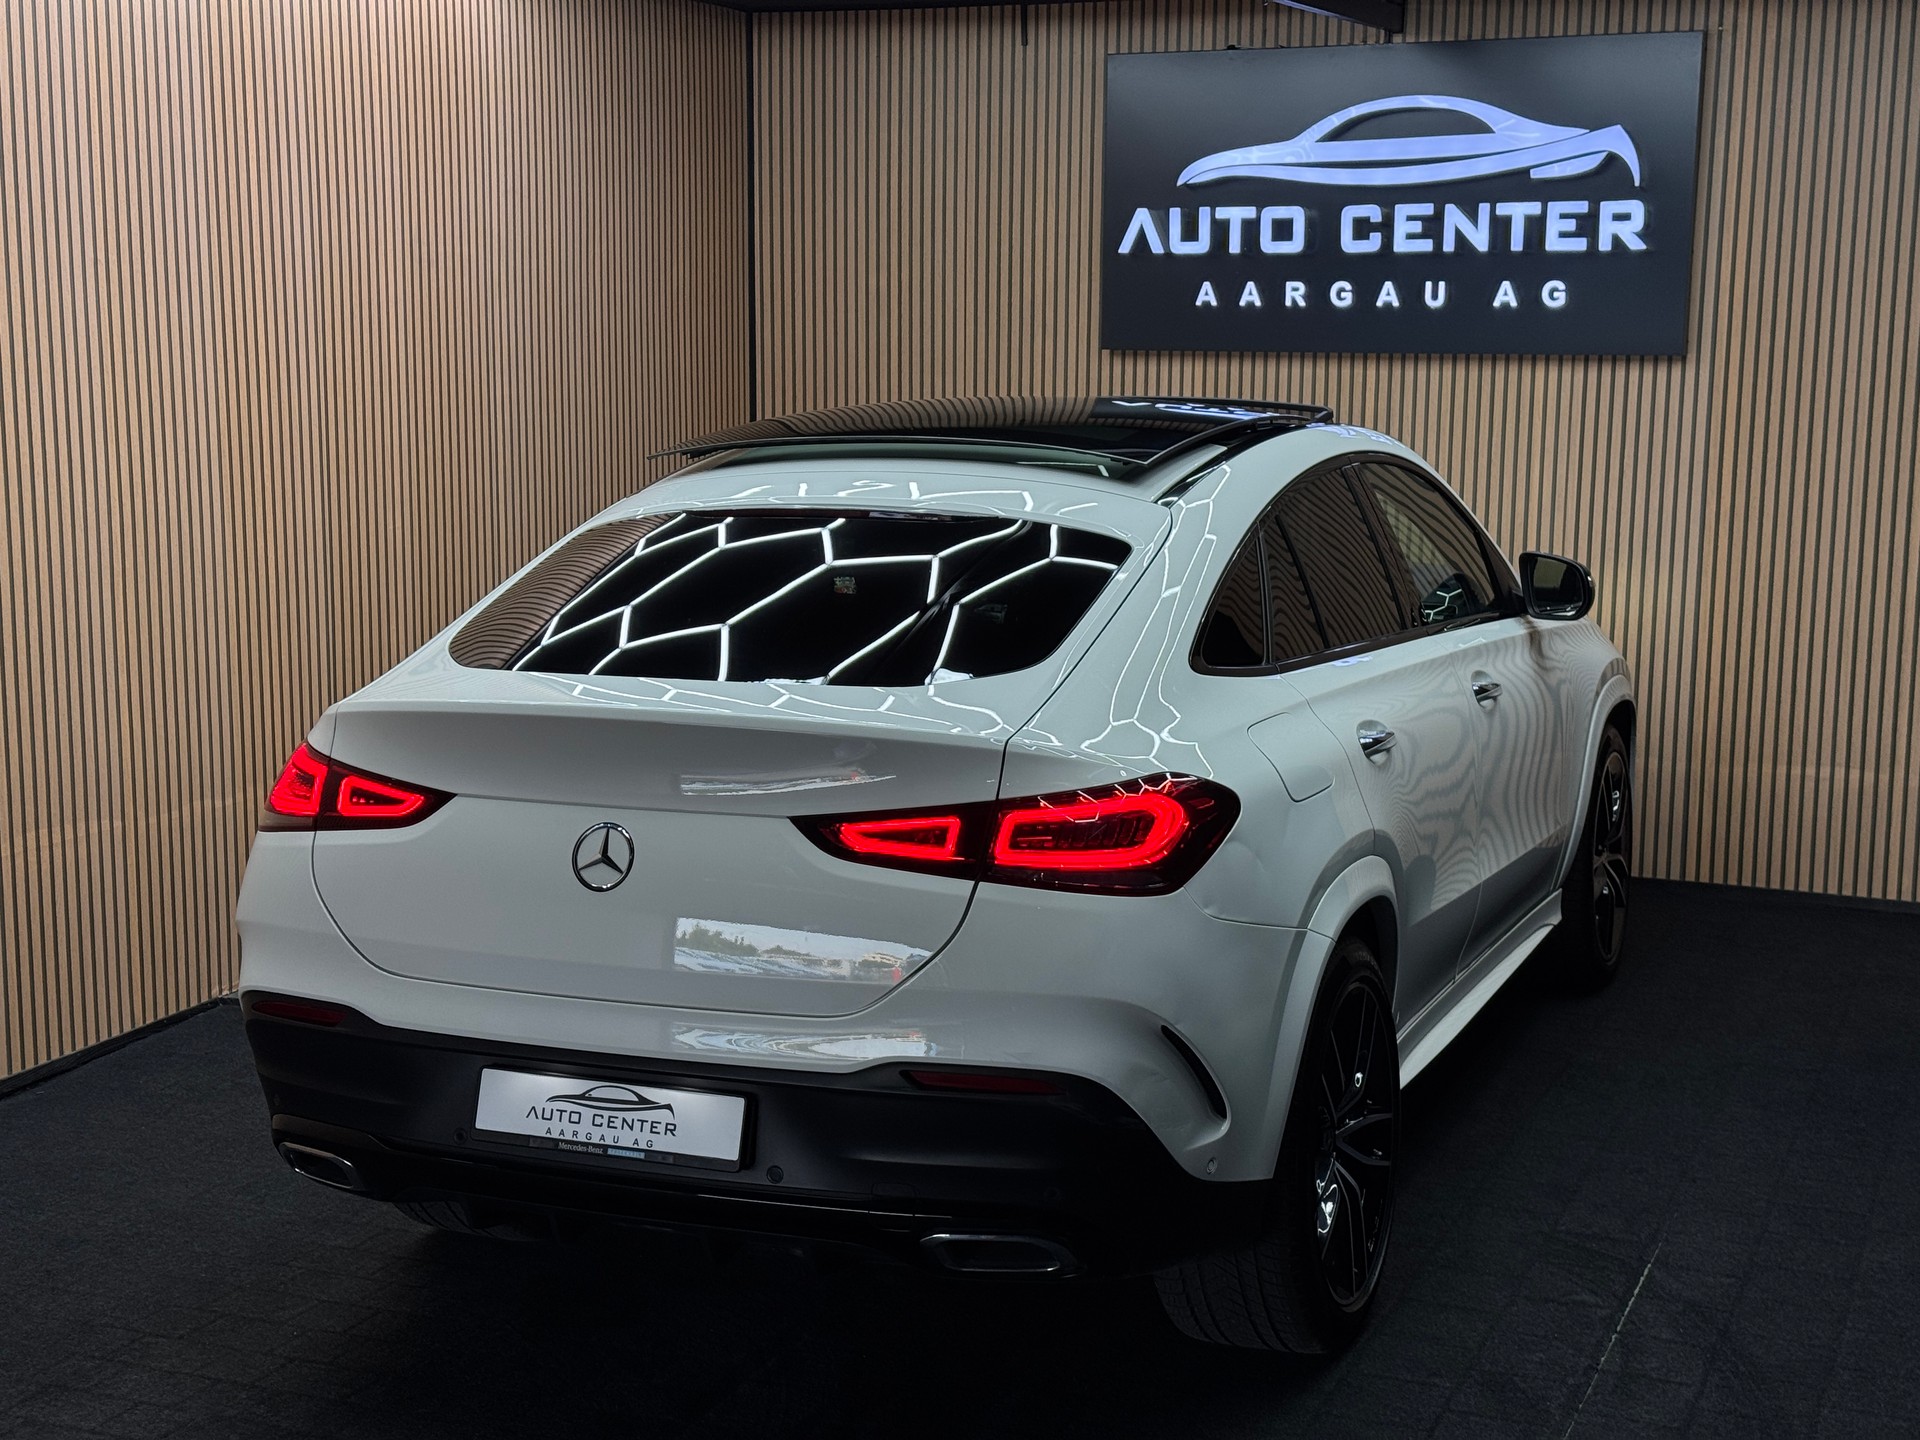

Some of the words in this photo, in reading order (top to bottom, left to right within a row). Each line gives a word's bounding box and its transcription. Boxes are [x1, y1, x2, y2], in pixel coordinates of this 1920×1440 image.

[1118, 205, 1306, 255] AUTO
[1340, 199, 1648, 254] CENTER
[1195, 280, 1446, 310] AARGAU
[1492, 279, 1567, 309] AG
[526, 1106, 582, 1125] AUTO
[592, 1114, 677, 1137] CENTER
[545, 1127, 620, 1144] AARGAU
[633, 1138, 654, 1149] AG
[558, 1142, 604, 1155] Mercedes-Benz
